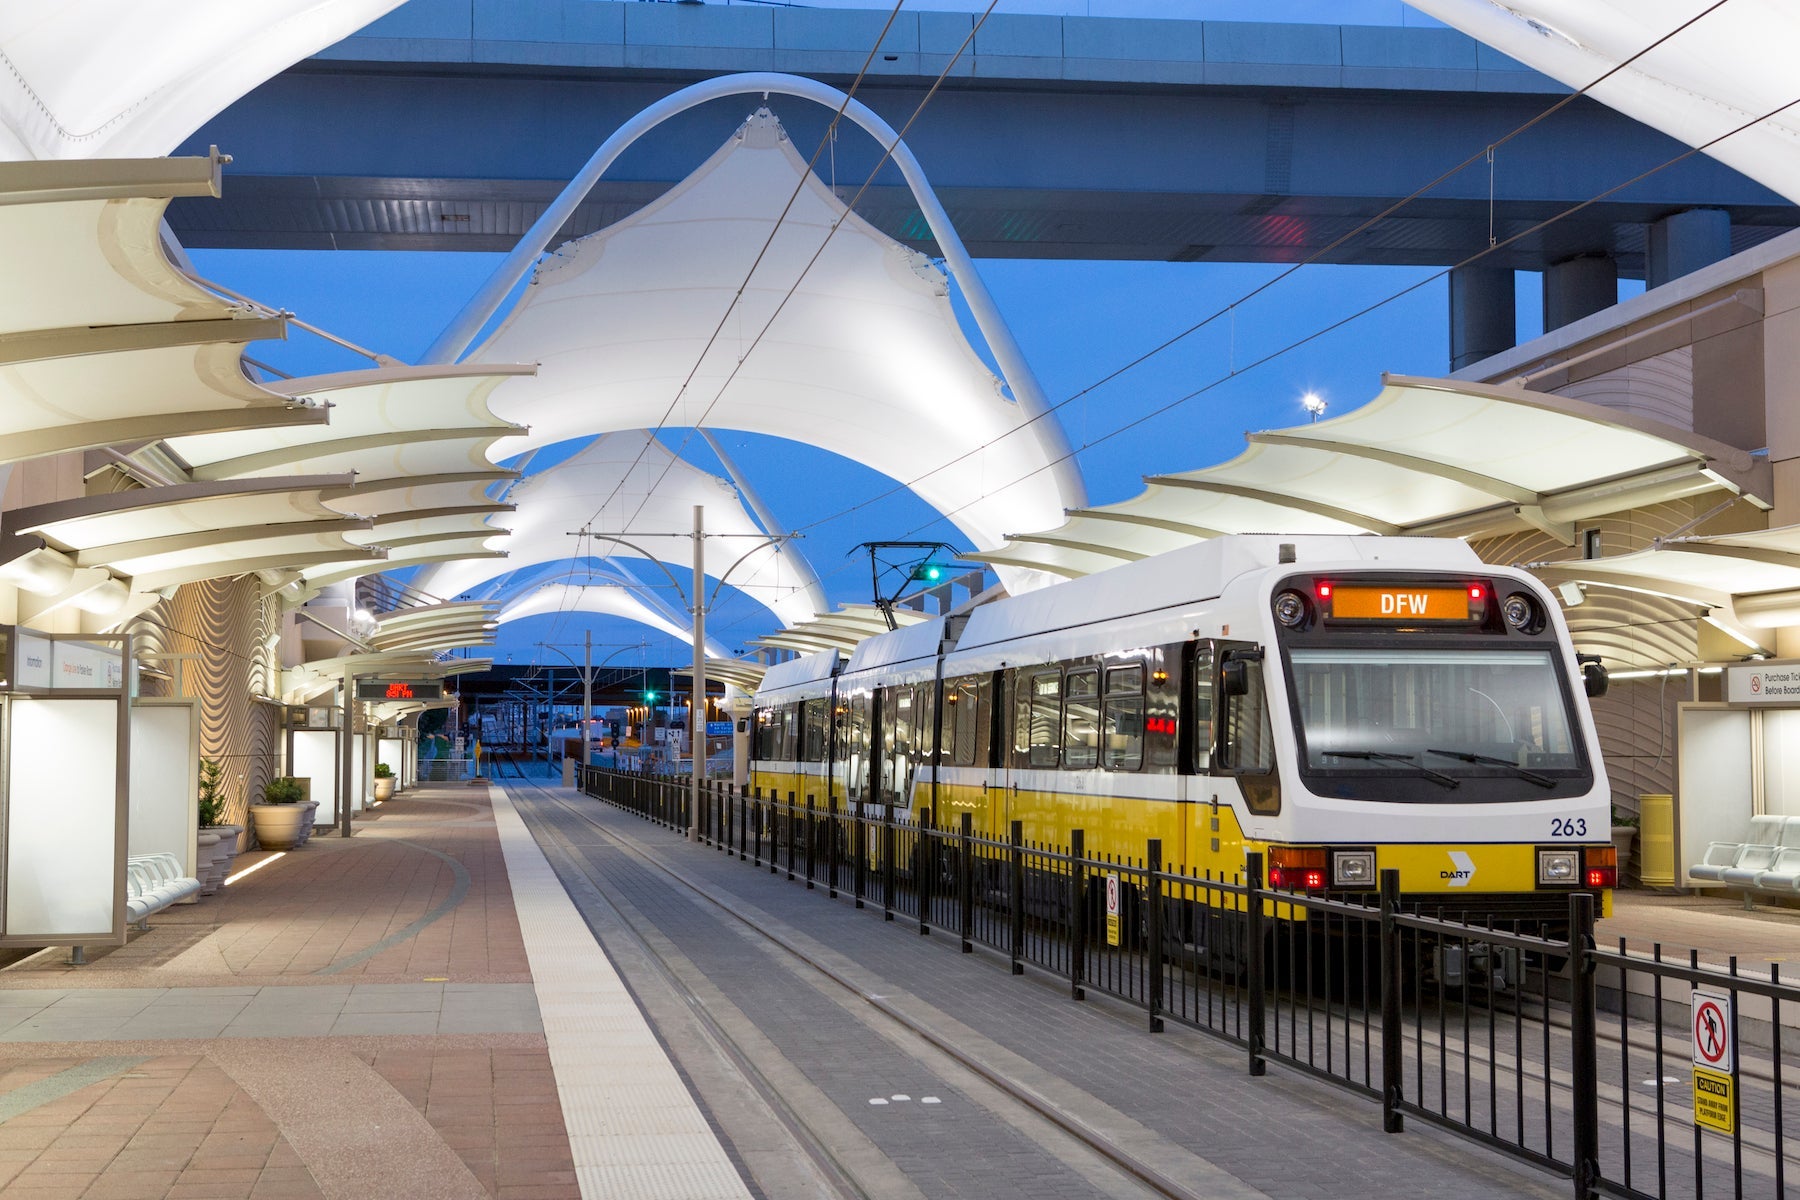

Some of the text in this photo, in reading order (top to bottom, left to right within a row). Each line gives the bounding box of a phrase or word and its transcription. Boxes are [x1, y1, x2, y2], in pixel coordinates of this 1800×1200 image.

[1381, 593, 1428, 614] DFW
[1765, 673, 1790, 682] Purchase
[1765, 686, 1782, 695] Before
[1551, 818, 1587, 836] 263
[1440, 871, 1470, 879] DART
[1700, 1078, 1726, 1096] CAUTION
